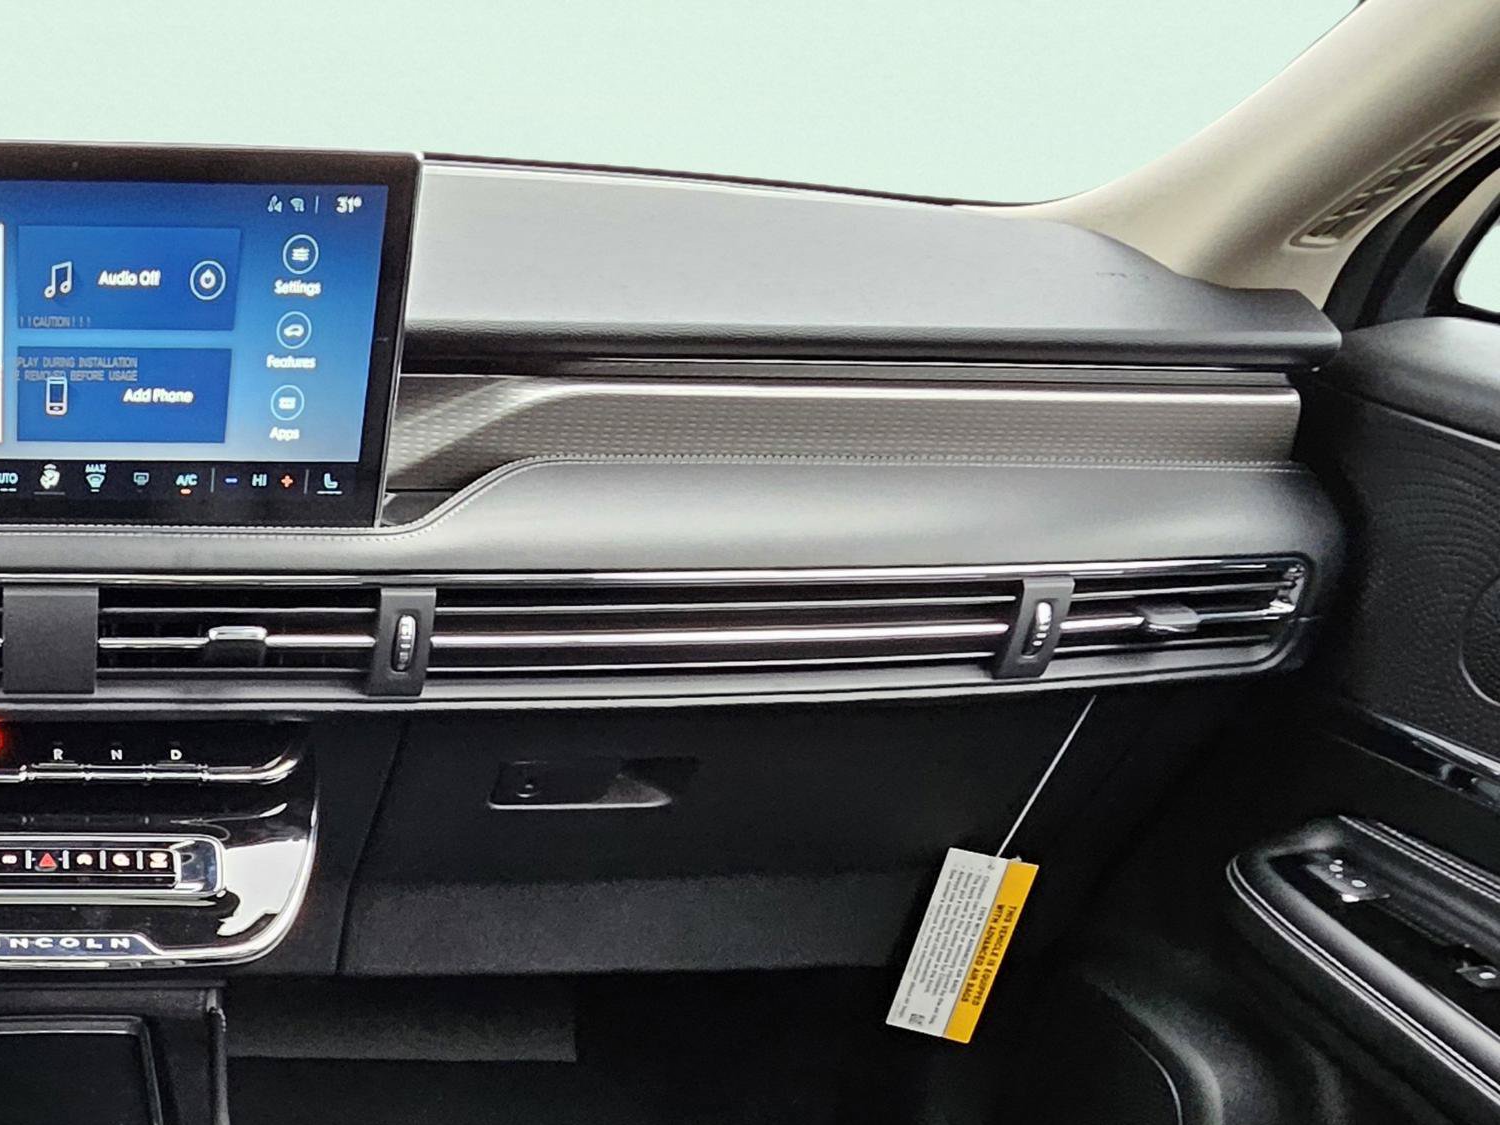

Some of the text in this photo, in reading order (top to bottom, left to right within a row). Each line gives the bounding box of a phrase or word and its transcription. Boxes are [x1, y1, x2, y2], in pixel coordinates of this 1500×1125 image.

[98, 270, 162, 287] Audio Off
[274, 278, 322, 297] Settings
[43, 356, 75, 368] DURING
[79, 357, 138, 369] INSTALLATION
[266, 355, 317, 370] Features
[70, 370, 105, 381] BEFORE
[108, 370, 138, 381] USAGE
[123, 388, 194, 404] Add Phone
[269, 427, 300, 441] Apps
[175, 474, 198, 487] A/C
[251, 474, 268, 487] HI
[53, 748, 64, 761] R
[111, 749, 123, 761] N
[170, 749, 183, 761] D
[1003, 905, 1017, 923] THIS
[990, 925, 1009, 957] VEHICLE
[960, 903, 1005, 1002] WITH ADVANCED AIR BAGS
[970, 968, 992, 1006] EQUIPPED
